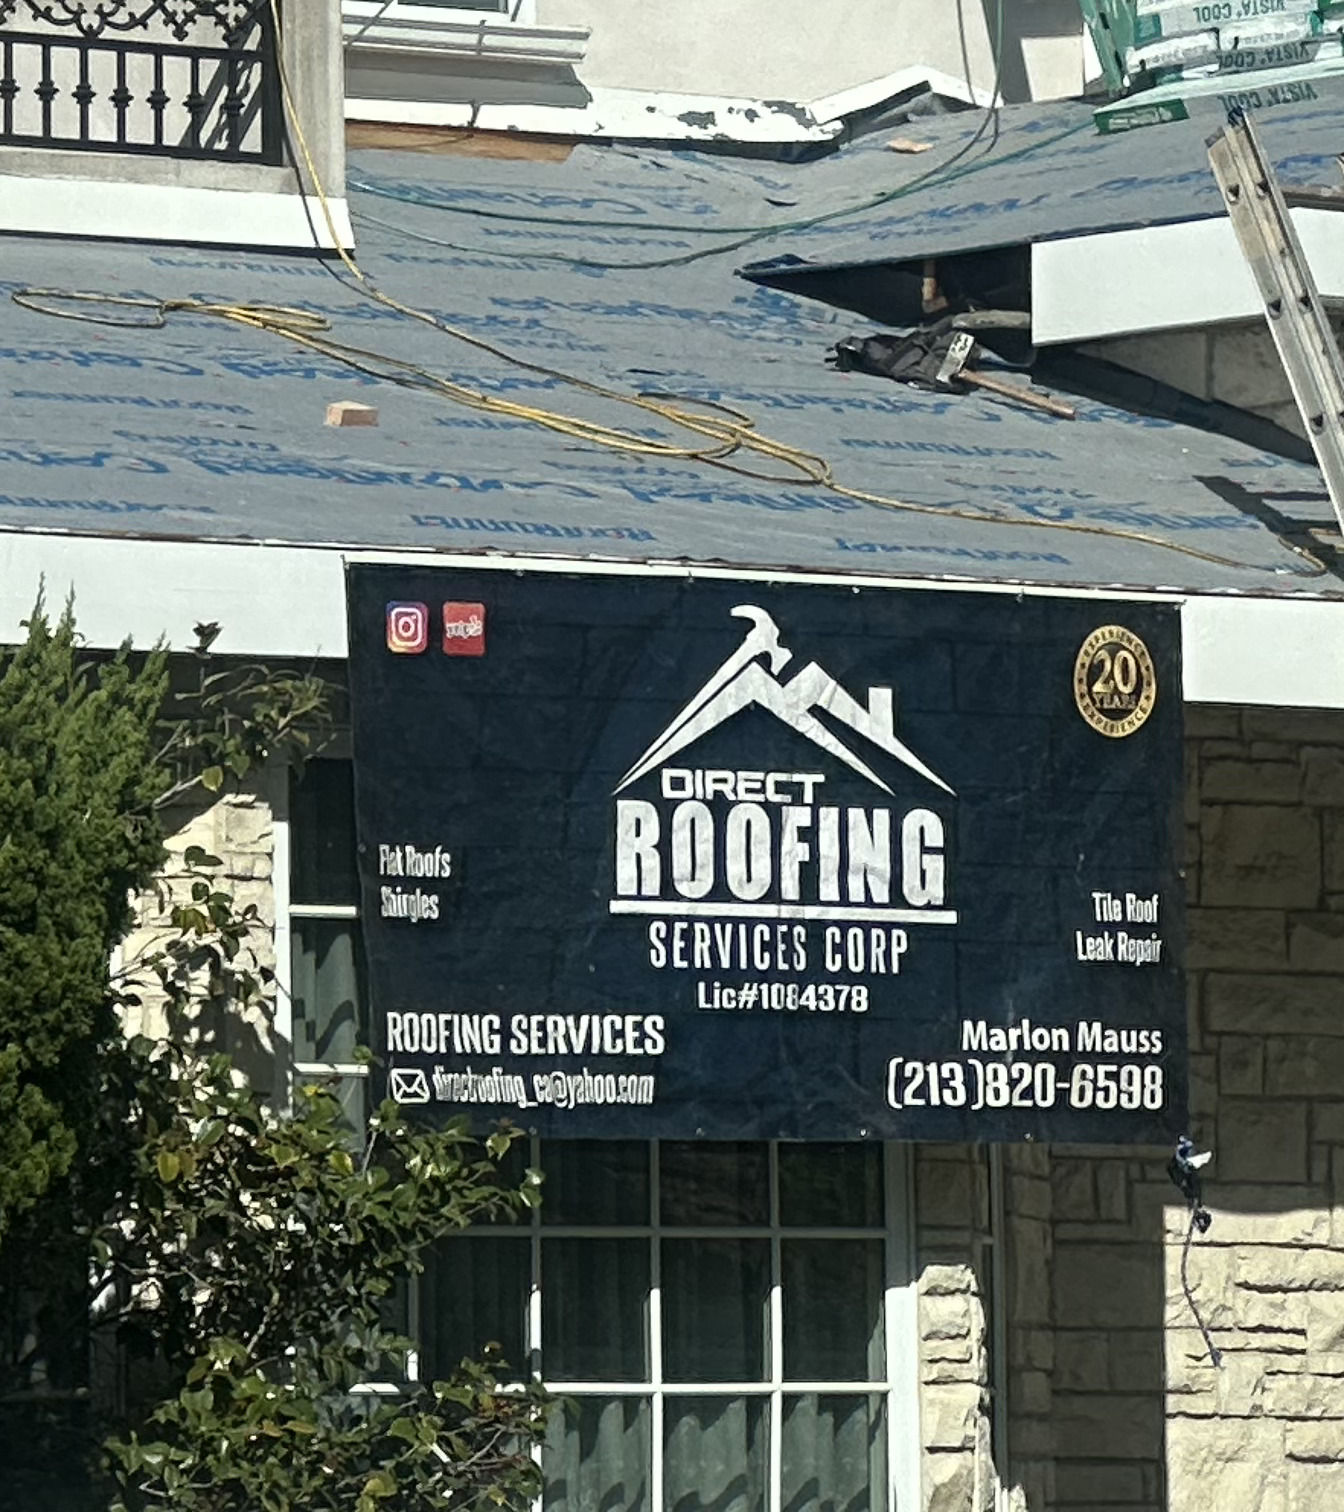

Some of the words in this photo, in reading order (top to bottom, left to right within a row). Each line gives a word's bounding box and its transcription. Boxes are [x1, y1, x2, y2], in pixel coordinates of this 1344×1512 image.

[1193, 2, 1232, 23] COOL
[1092, 648, 1137, 694] 20
[661, 768, 825, 804] DIRECT
[379, 843, 404, 876] Flat
[405, 845, 451, 878] Roofs
[616, 799, 944, 906] ROOFING
[381, 886, 439, 923] Shingles
[1091, 892, 1122, 922] Tile
[1126, 892, 1159, 923] Roof
[649, 920, 807, 971] SERVICES
[825, 927, 908, 974] CORP
[1076, 930, 1115, 961] Leak
[1117, 931, 1163, 967] Repair
[386, 1011, 501, 1055] ROOFING
[510, 1014, 666, 1056] SERVICES
[962, 1018, 1070, 1052] Marlon
[1077, 1020, 1164, 1055] Mauss
[887, 1056, 1164, 1111] (213)820-6598
